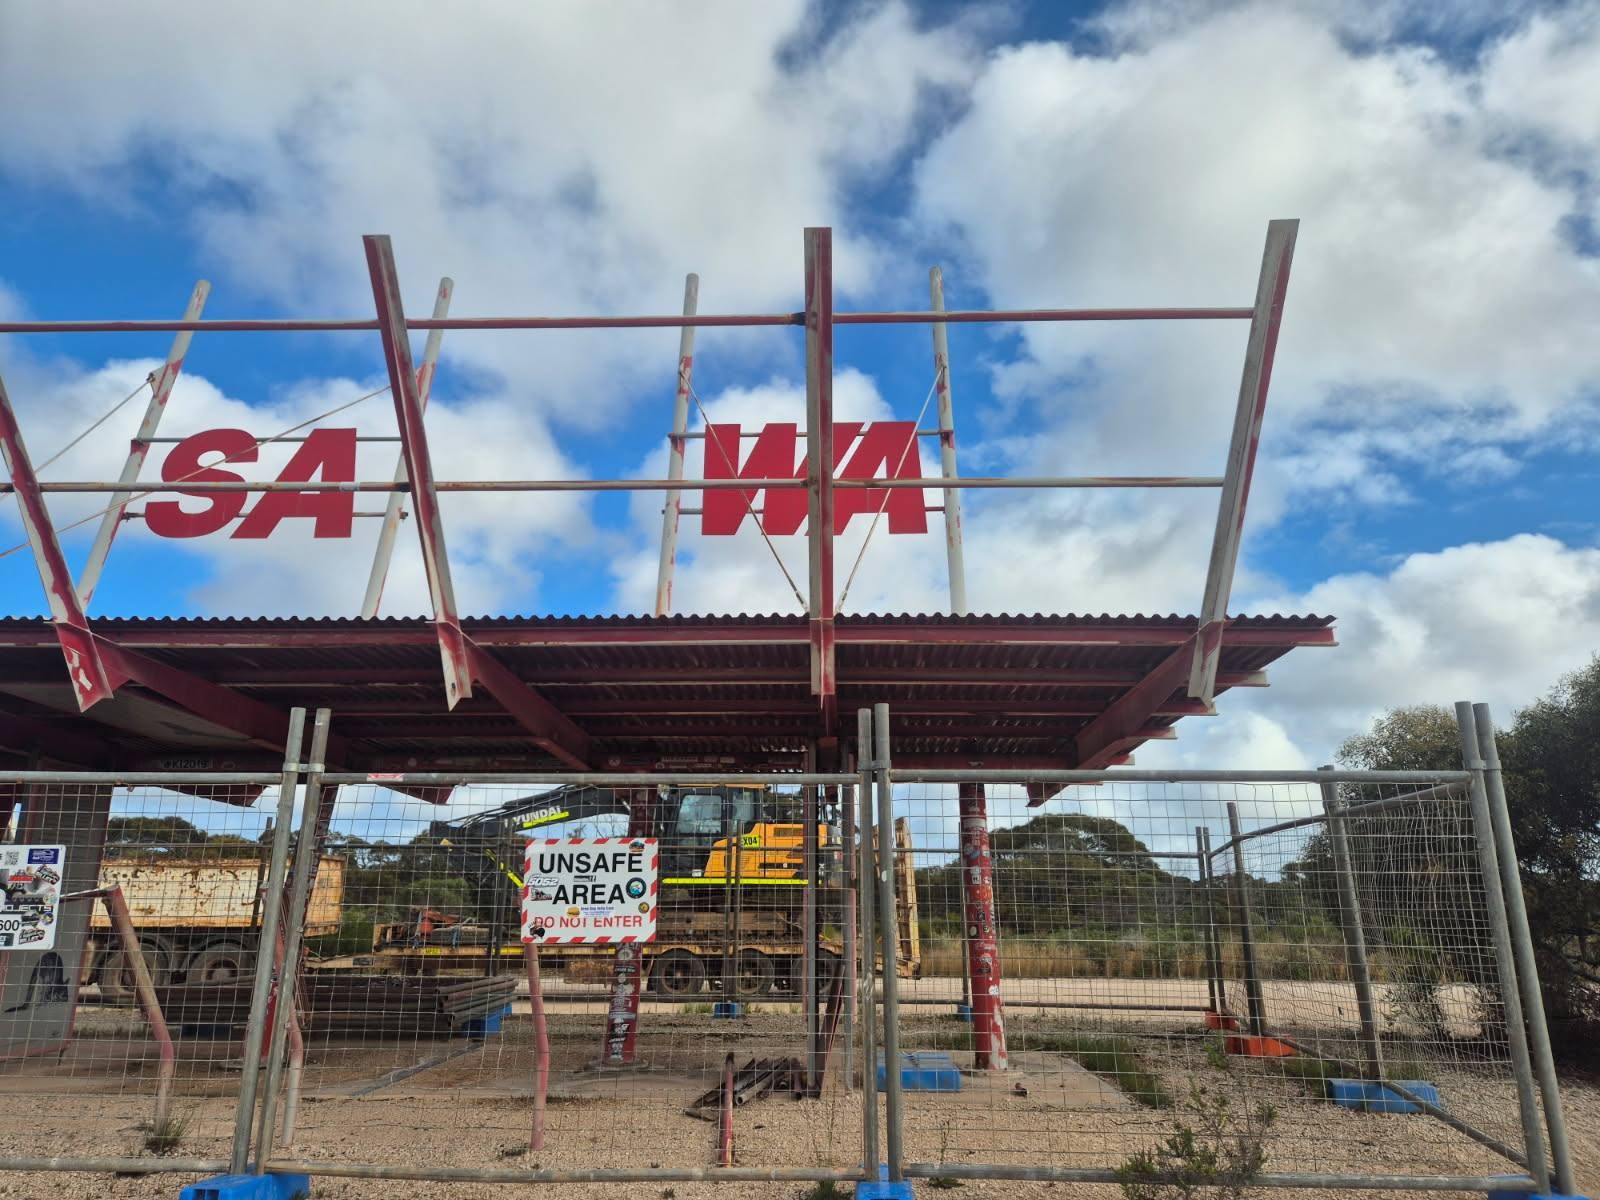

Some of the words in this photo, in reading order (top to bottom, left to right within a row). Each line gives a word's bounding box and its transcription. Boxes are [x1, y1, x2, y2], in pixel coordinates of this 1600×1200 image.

[144, 428, 357, 539] SA
[701, 421, 928, 535] WA
[539, 852, 643, 874] UNSAFE
[552, 883, 626, 905] AREA
[534, 916, 555, 928] DO
[560, 915, 587, 928] NOT
[593, 915, 642, 928] ENTER
